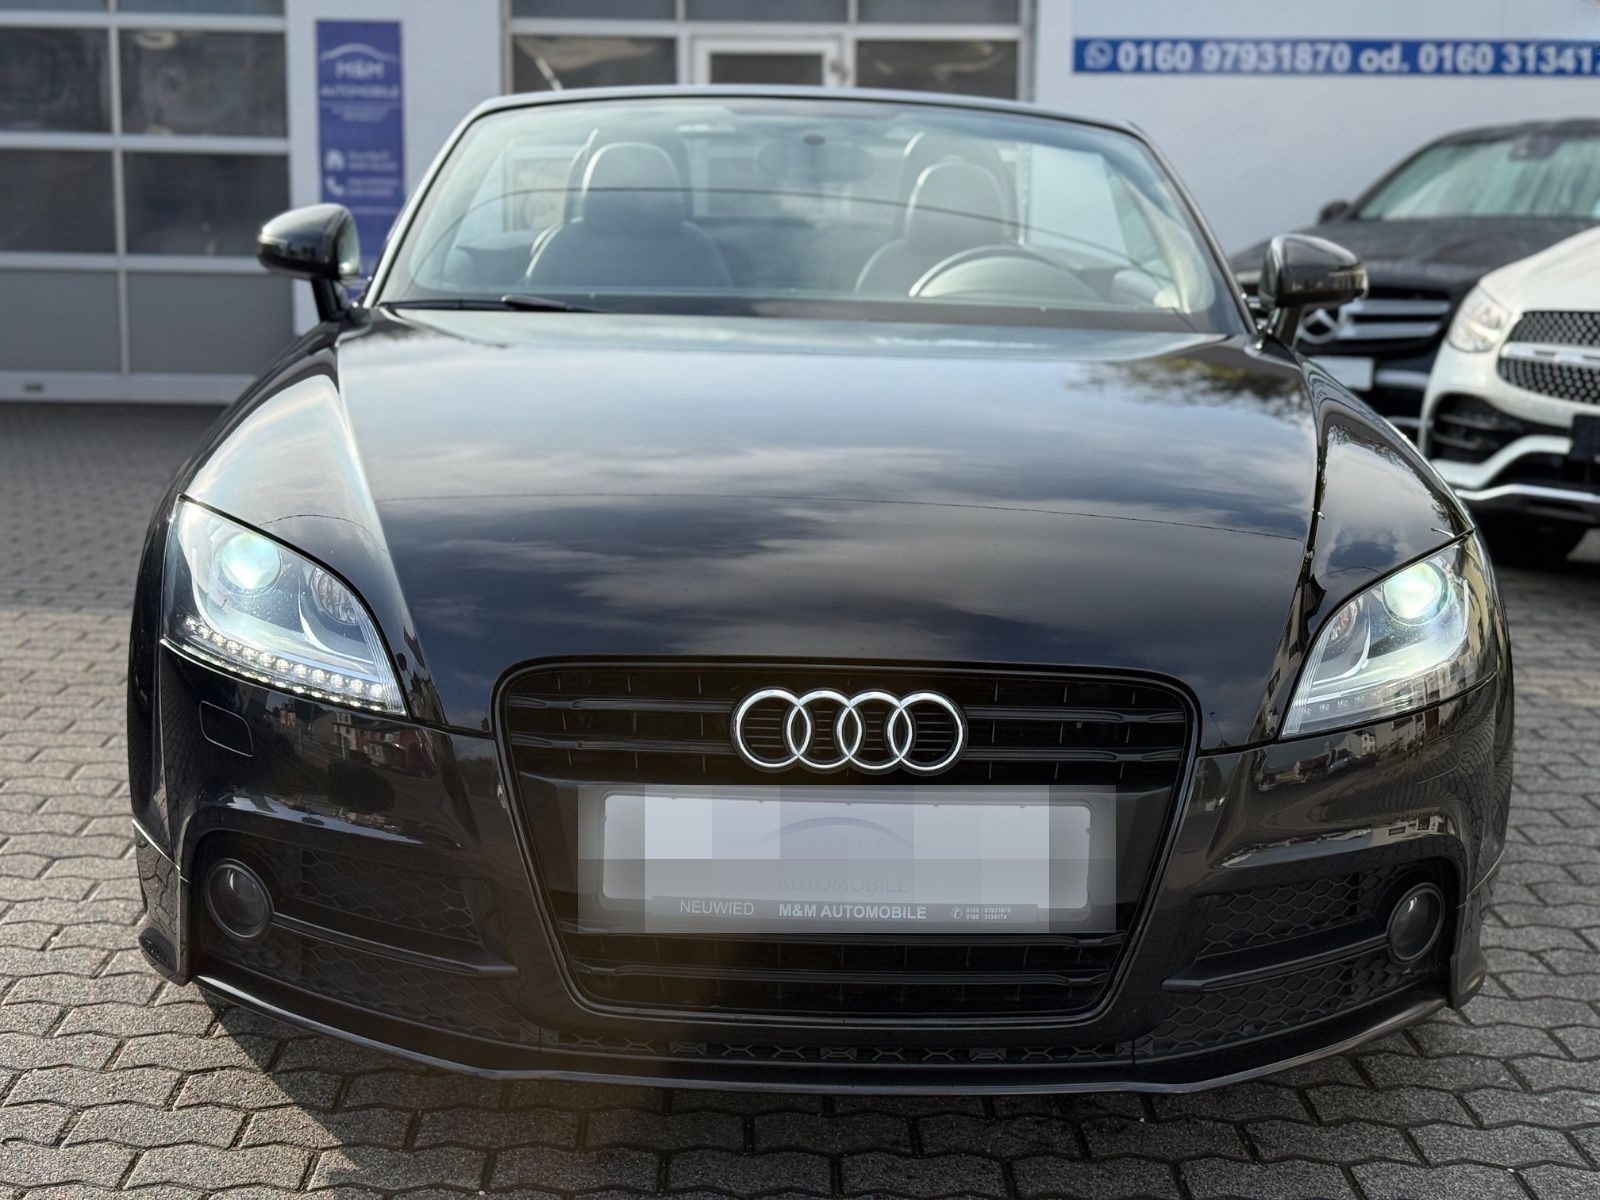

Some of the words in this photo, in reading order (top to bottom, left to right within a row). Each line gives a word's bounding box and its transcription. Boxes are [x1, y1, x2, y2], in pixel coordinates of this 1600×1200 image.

[1117, 42, 1193, 72] 0160
[1201, 42, 1351, 73] 97931870
[1358, 43, 1410, 73] od.
[1418, 43, 1495, 73] 0160
[1501, 43, 1600, 74] 31341
[775, 874, 910, 893] AUTOMOBILE
[679, 900, 755, 916] NEUWIED
[778, 903, 817, 918] M&M
[820, 905, 927, 920] AUTOMOBILE
